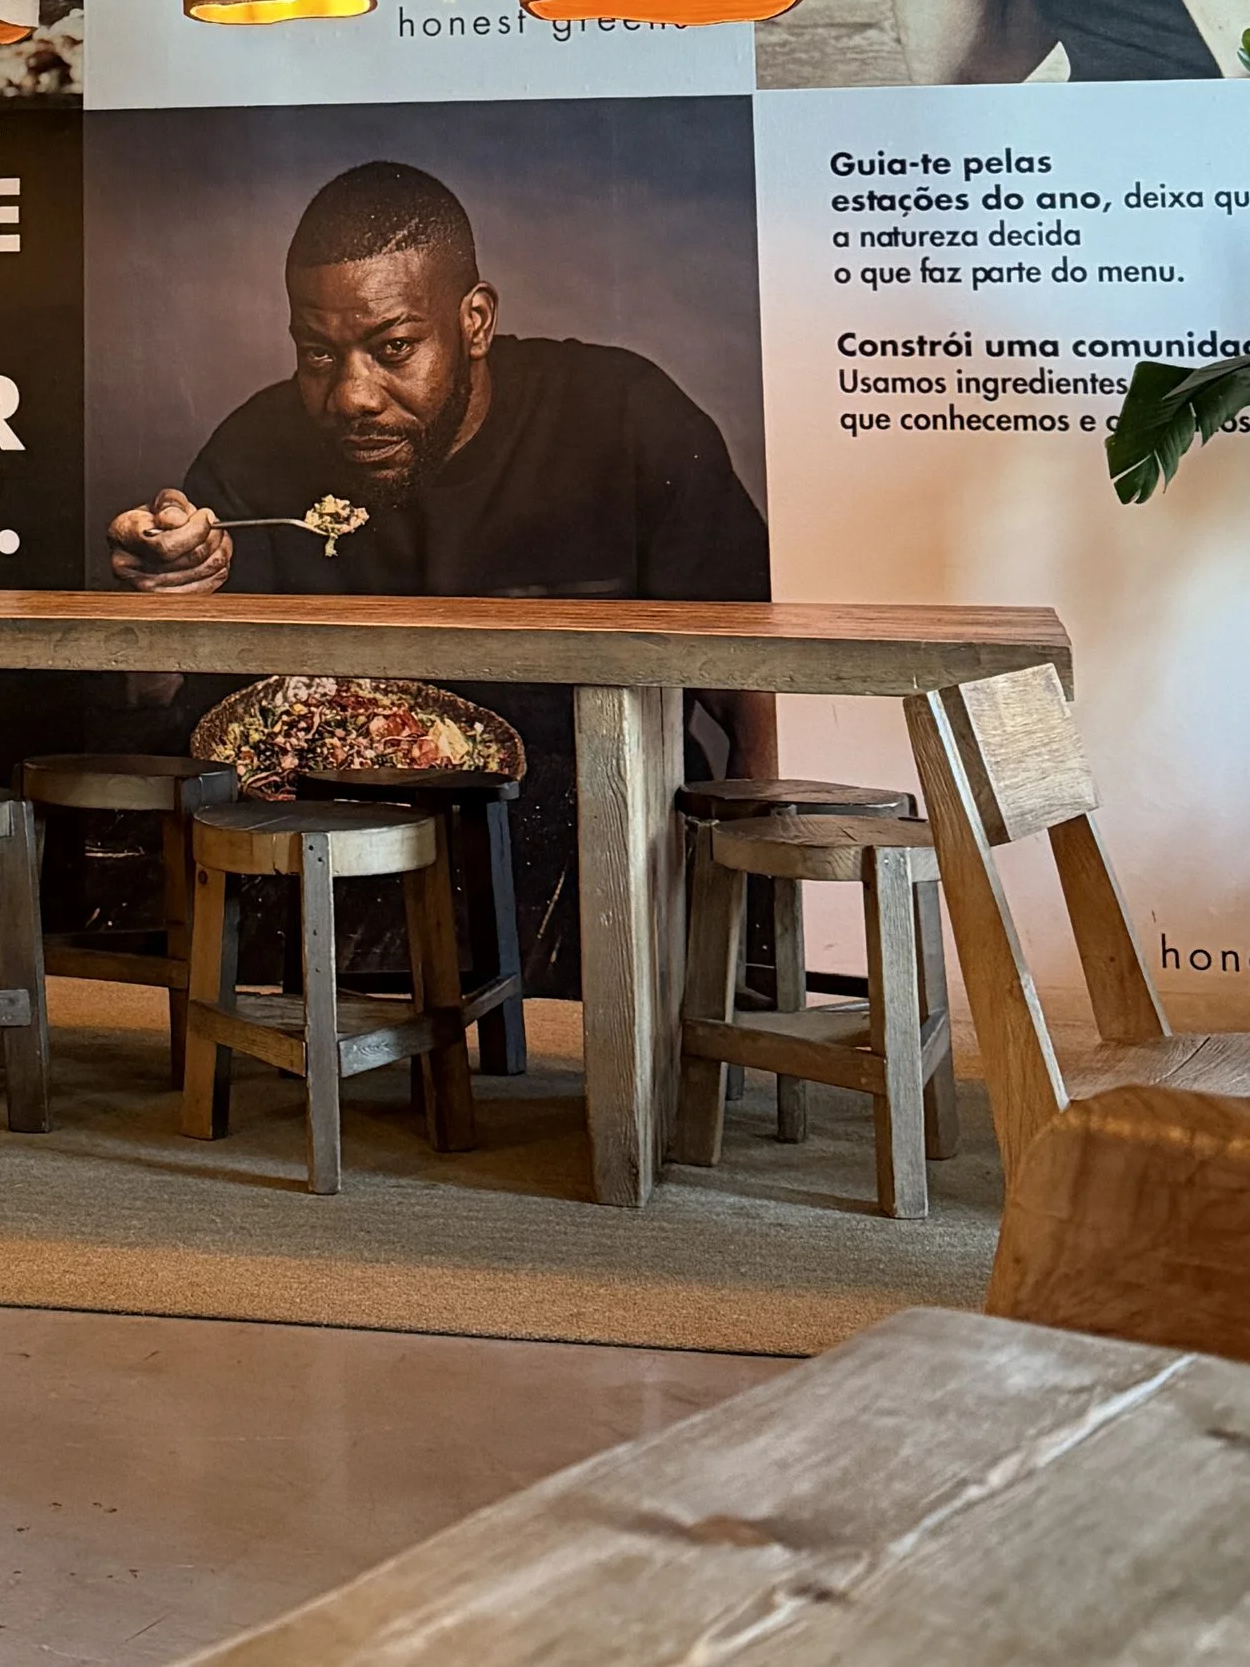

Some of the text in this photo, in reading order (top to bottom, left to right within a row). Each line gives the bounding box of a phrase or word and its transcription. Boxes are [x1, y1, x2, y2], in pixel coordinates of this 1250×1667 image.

[399, 6, 526, 37] honest
[830, 147, 1052, 182] Guia-te pelas
[831, 186, 969, 218] estações
[981, 183, 1024, 211] do
[1035, 191, 1112, 213] ano,
[1124, 181, 1204, 209] deixa
[832, 218, 1081, 248] a natureza decida
[834, 255, 1185, 292] o que faz parte do menu.
[837, 330, 973, 358] Constrói
[985, 339, 1060, 358] uma
[839, 364, 1129, 402] Usamos ingredientes
[840, 413, 891, 438] que
[900, 403, 1070, 432] conhecemos
[1079, 414, 1097, 432] e
